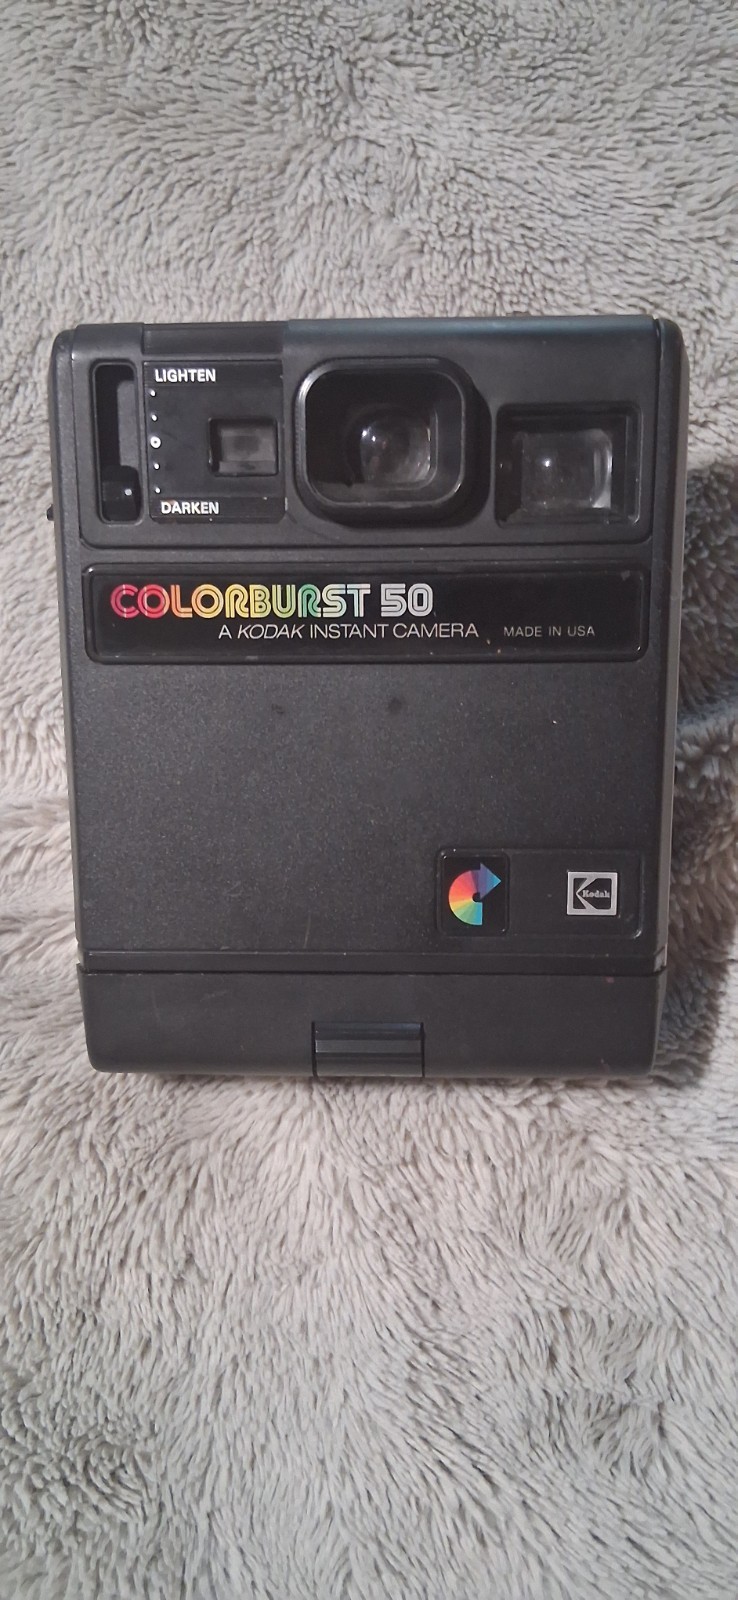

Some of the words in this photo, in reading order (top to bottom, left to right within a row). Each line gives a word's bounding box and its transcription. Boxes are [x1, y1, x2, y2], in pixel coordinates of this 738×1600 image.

[155, 368, 216, 382] LIGHTEN
[161, 501, 219, 515] DARKEN
[110, 583, 371, 619] COLORBURST
[381, 583, 434, 618] 50
[218, 624, 232, 639] A
[237, 624, 305, 639] KODAK
[310, 623, 389, 639] INSTANT
[393, 623, 479, 639] CAMERA
[503, 626, 542, 637] MADE
[549, 626, 562, 637] IN
[567, 626, 596, 637] USA
[582, 890, 610, 898] Kodak
